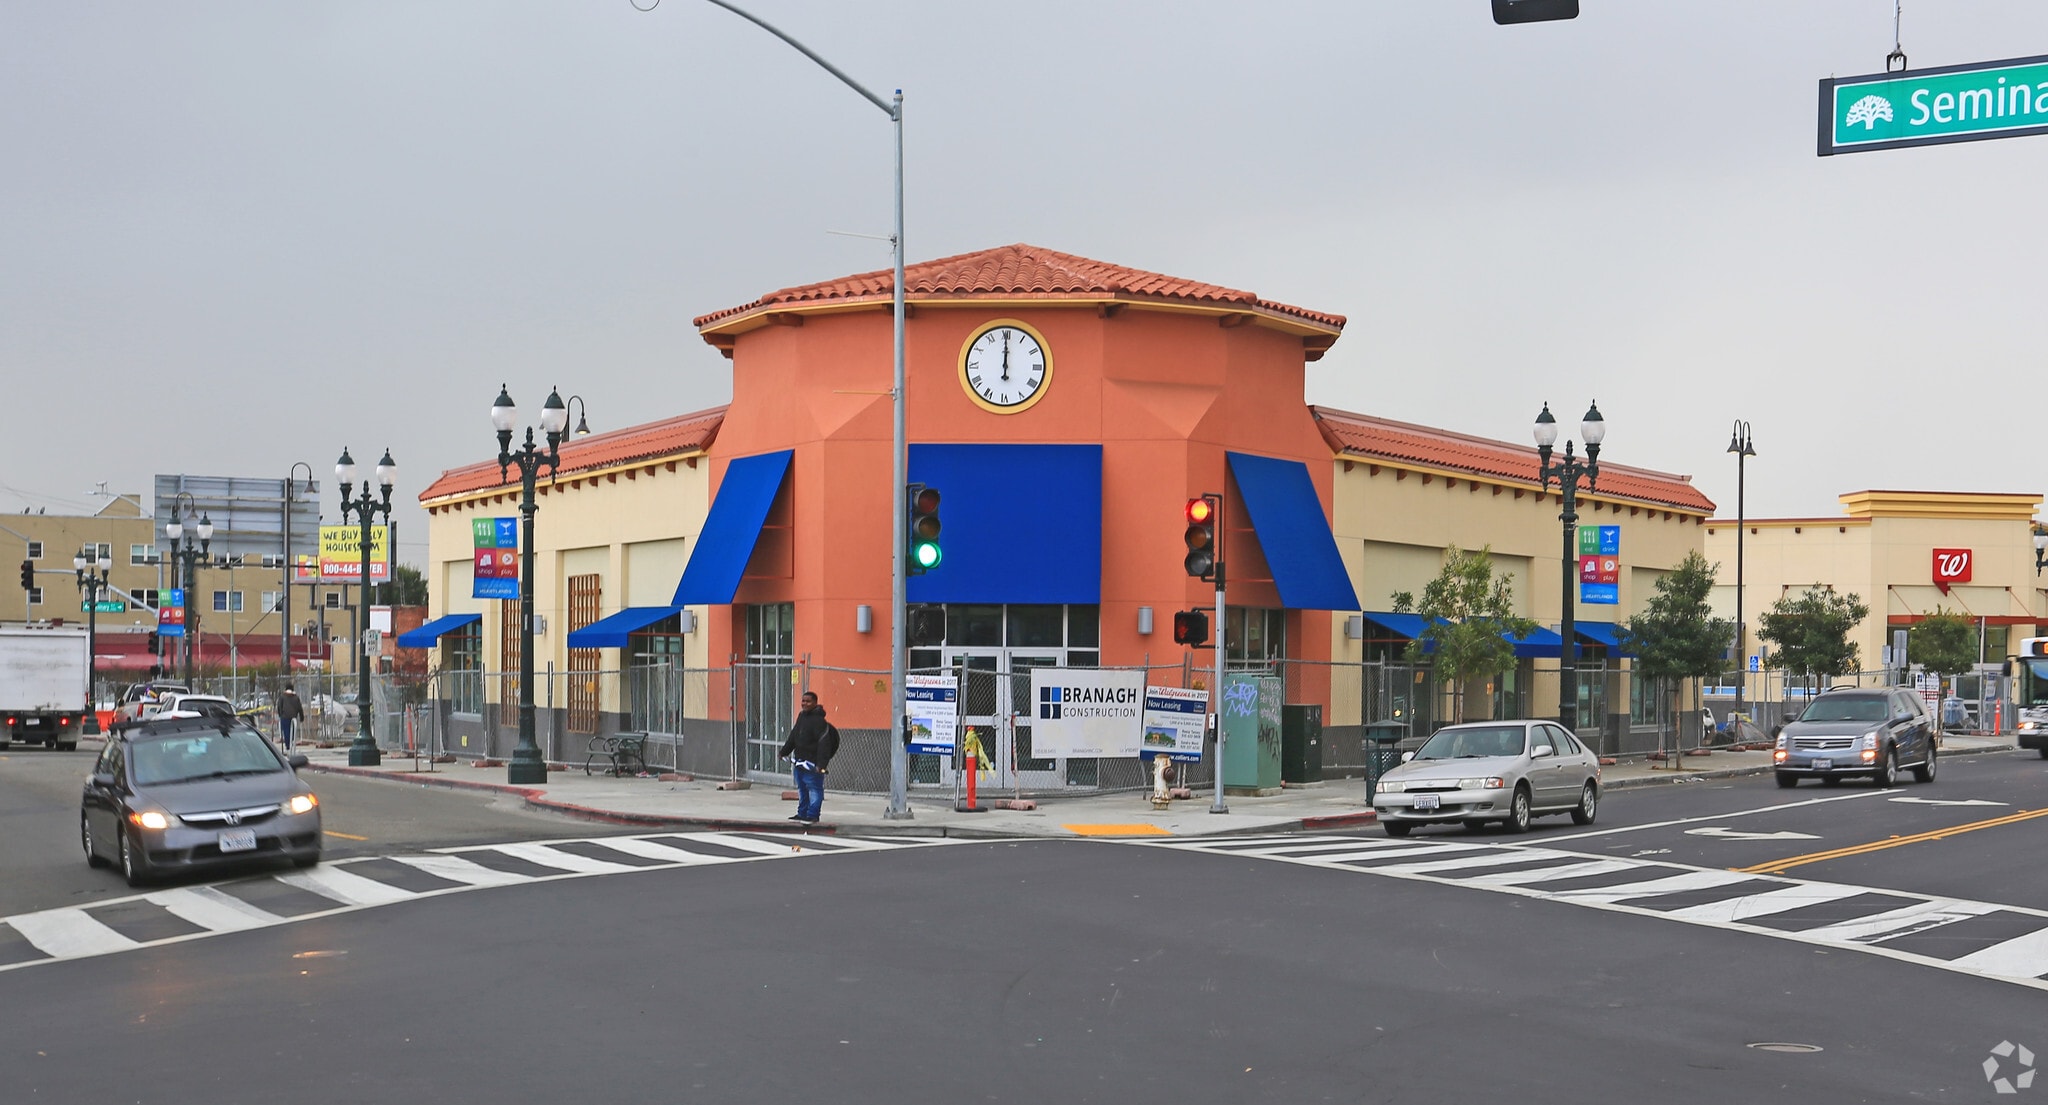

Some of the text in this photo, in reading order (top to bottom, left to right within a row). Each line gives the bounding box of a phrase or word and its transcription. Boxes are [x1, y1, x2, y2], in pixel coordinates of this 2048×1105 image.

[324, 531, 337, 540] WE
[342, 529, 358, 541] BUY
[323, 563, 383, 574] 800-44-BER
[1937, 552, 1968, 577] W
[1602, 574, 1615, 582] play
[914, 675, 942, 687] Walgreens
[916, 690, 934, 701] Leasing
[1063, 687, 1137, 704] BRANAGH
[1148, 687, 1158, 695] Join
[1158, 687, 1191, 699] Walgreens
[1148, 700, 1182, 711] Now Leasing
[1063, 707, 1136, 718] CONSTRUCTION
[1170, 753, 1199, 761] w.colliers.com
